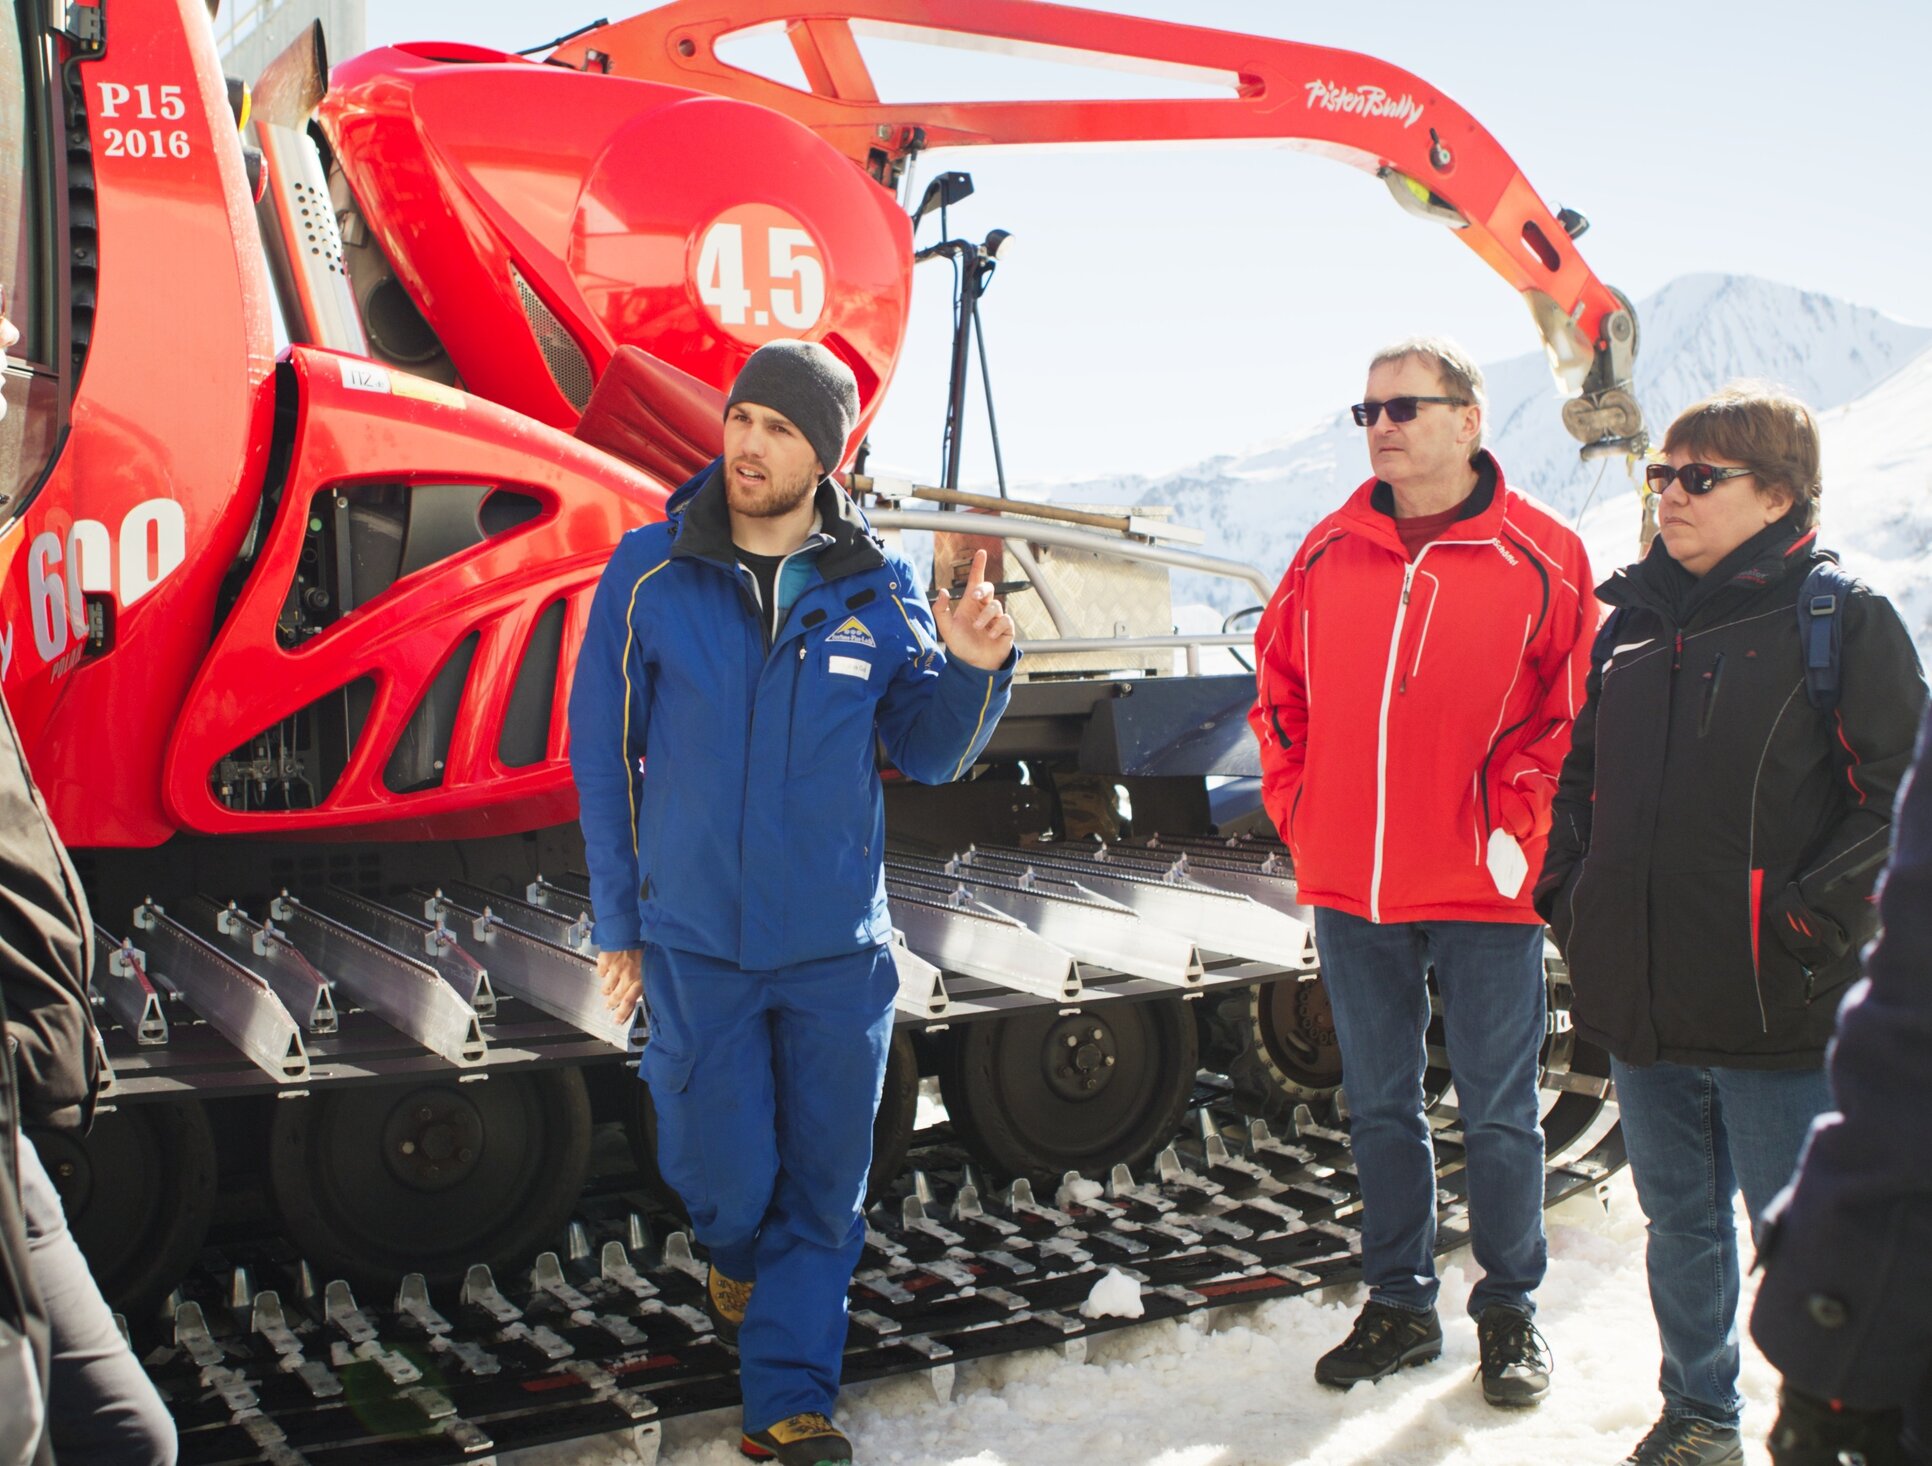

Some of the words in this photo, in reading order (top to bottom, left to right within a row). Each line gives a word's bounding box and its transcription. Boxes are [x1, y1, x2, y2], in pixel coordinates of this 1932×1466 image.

[97, 81, 186, 120] P15
[1304, 79, 1424, 128] PistenBully
[103, 128, 191, 159] 2016
[697, 222, 826, 330] 4.5
[28, 498, 186, 663] 600
